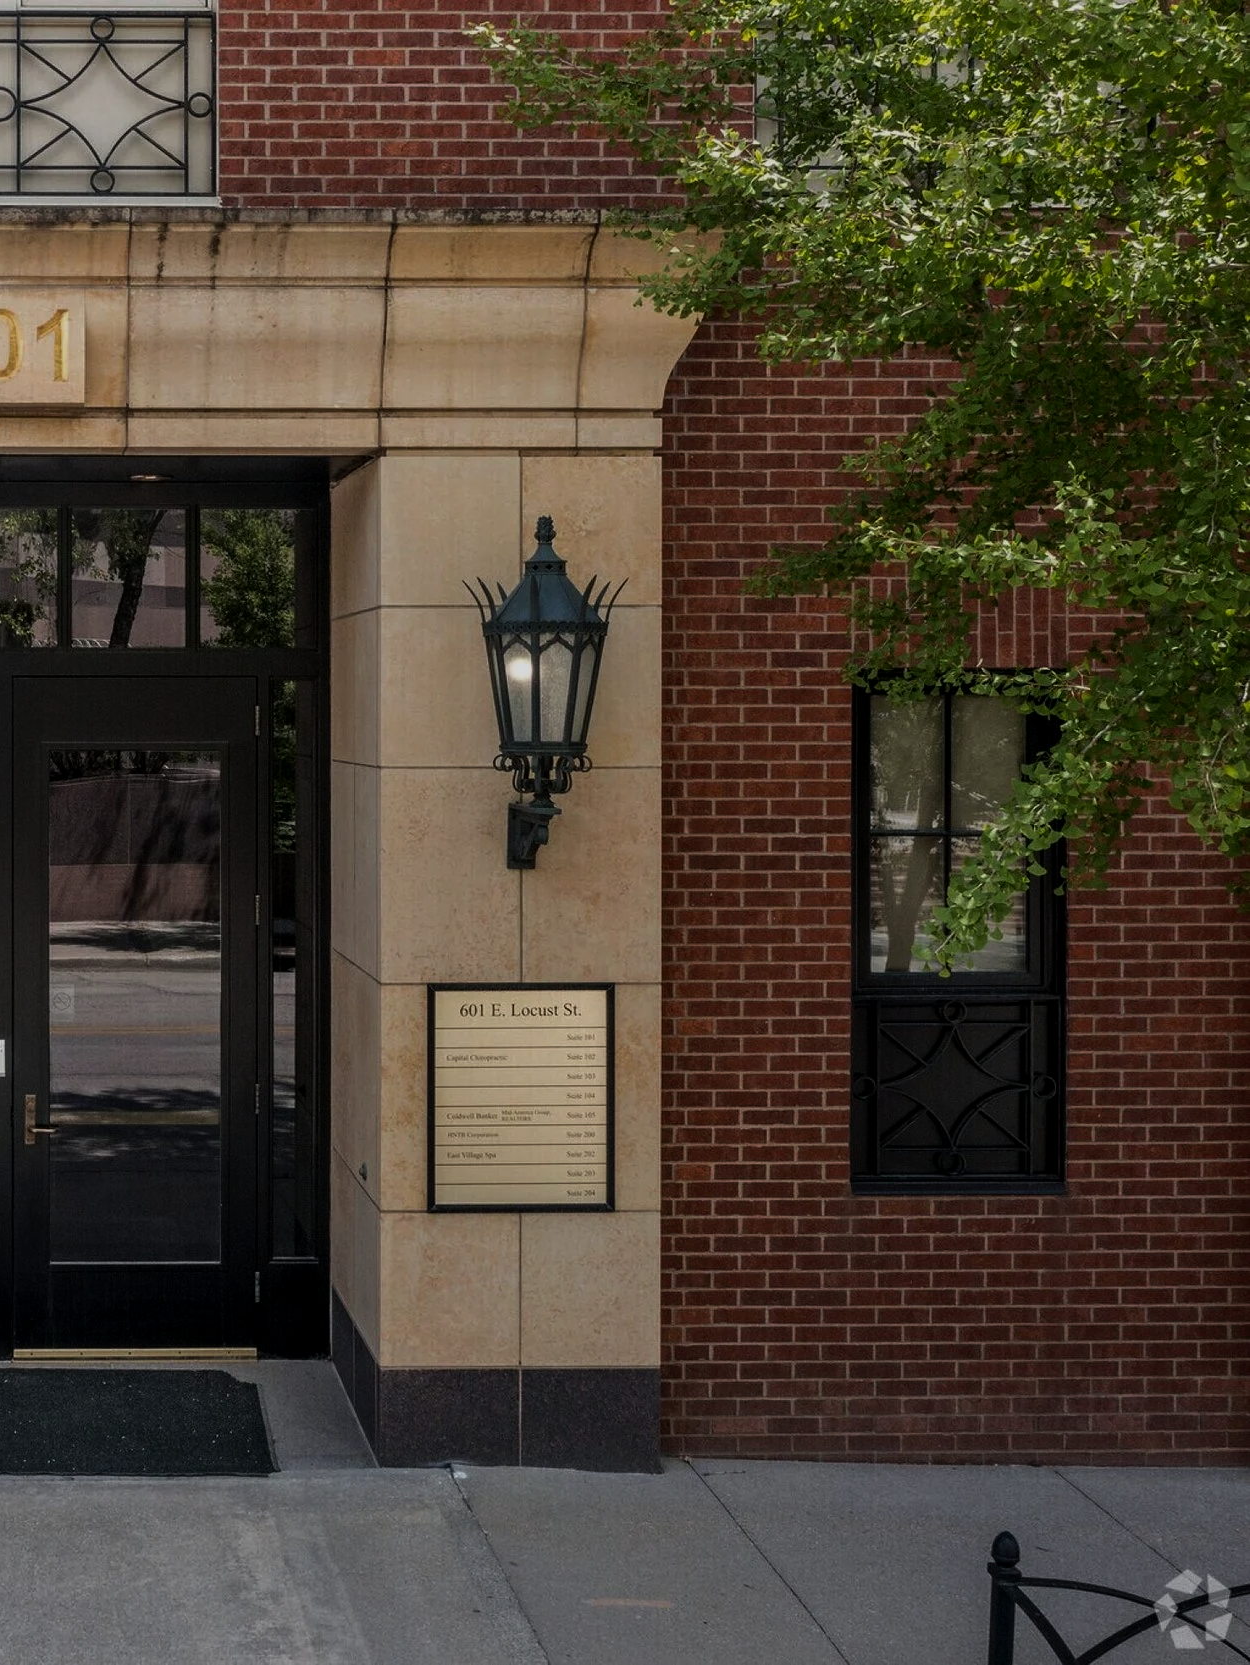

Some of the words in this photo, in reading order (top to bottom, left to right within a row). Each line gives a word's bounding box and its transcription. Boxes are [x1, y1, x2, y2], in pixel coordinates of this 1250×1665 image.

[459, 1003, 484, 1017] 601
[491, 1003, 506, 1017] E.
[511, 1003, 558, 1017] Locust
[563, 1002, 582, 1017] St.
[461, 1152, 483, 1160] Village
[484, 1152, 497, 1160] Spa
